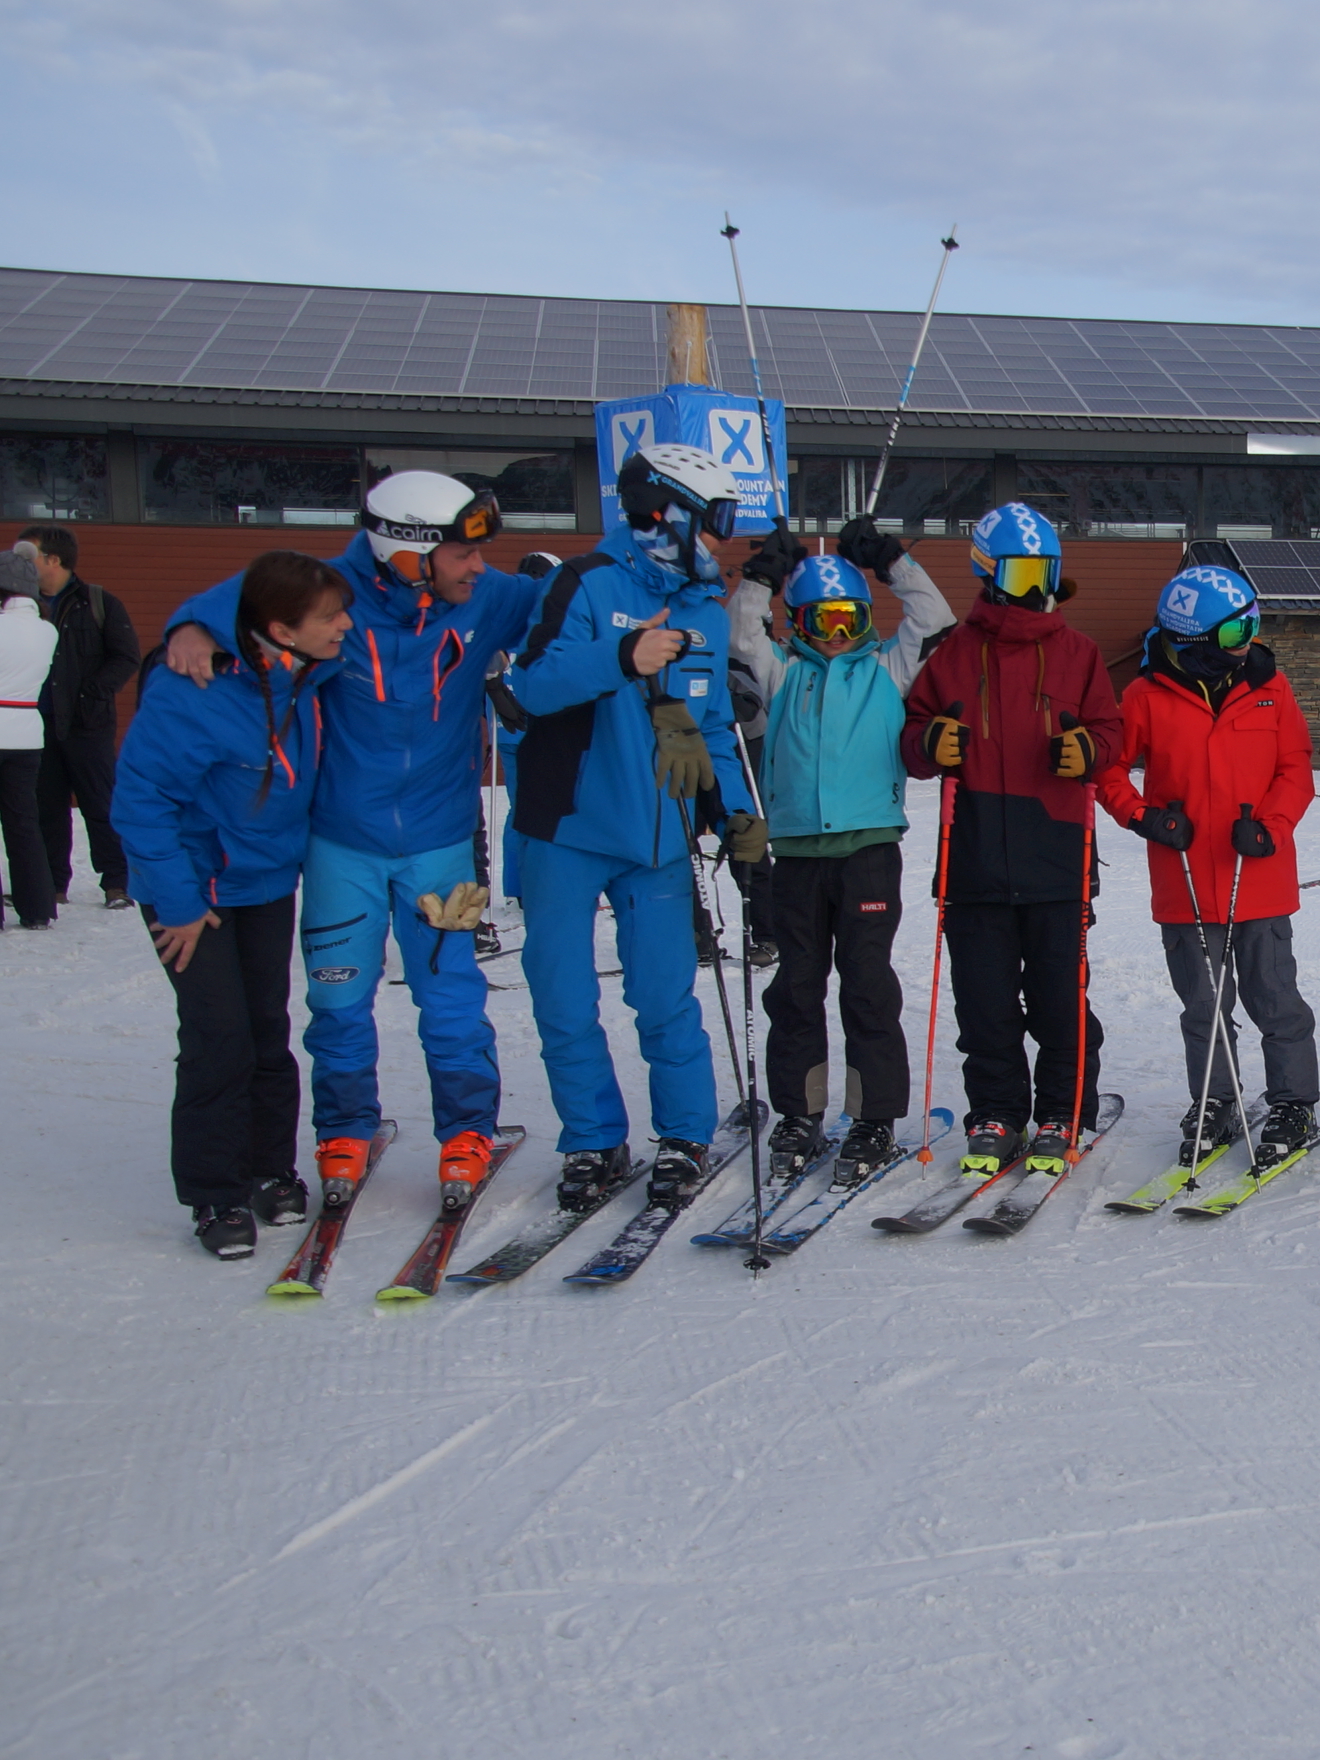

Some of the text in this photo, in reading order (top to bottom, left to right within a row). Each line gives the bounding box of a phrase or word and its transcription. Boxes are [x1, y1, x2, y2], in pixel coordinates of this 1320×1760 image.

[661, 477, 709, 511] GRANDVALIRA
[390, 525, 444, 542] cairn
[690, 852, 711, 911] ATOMIC
[319, 968, 351, 982] Ford
[746, 1009, 756, 1062] ATOMIC
